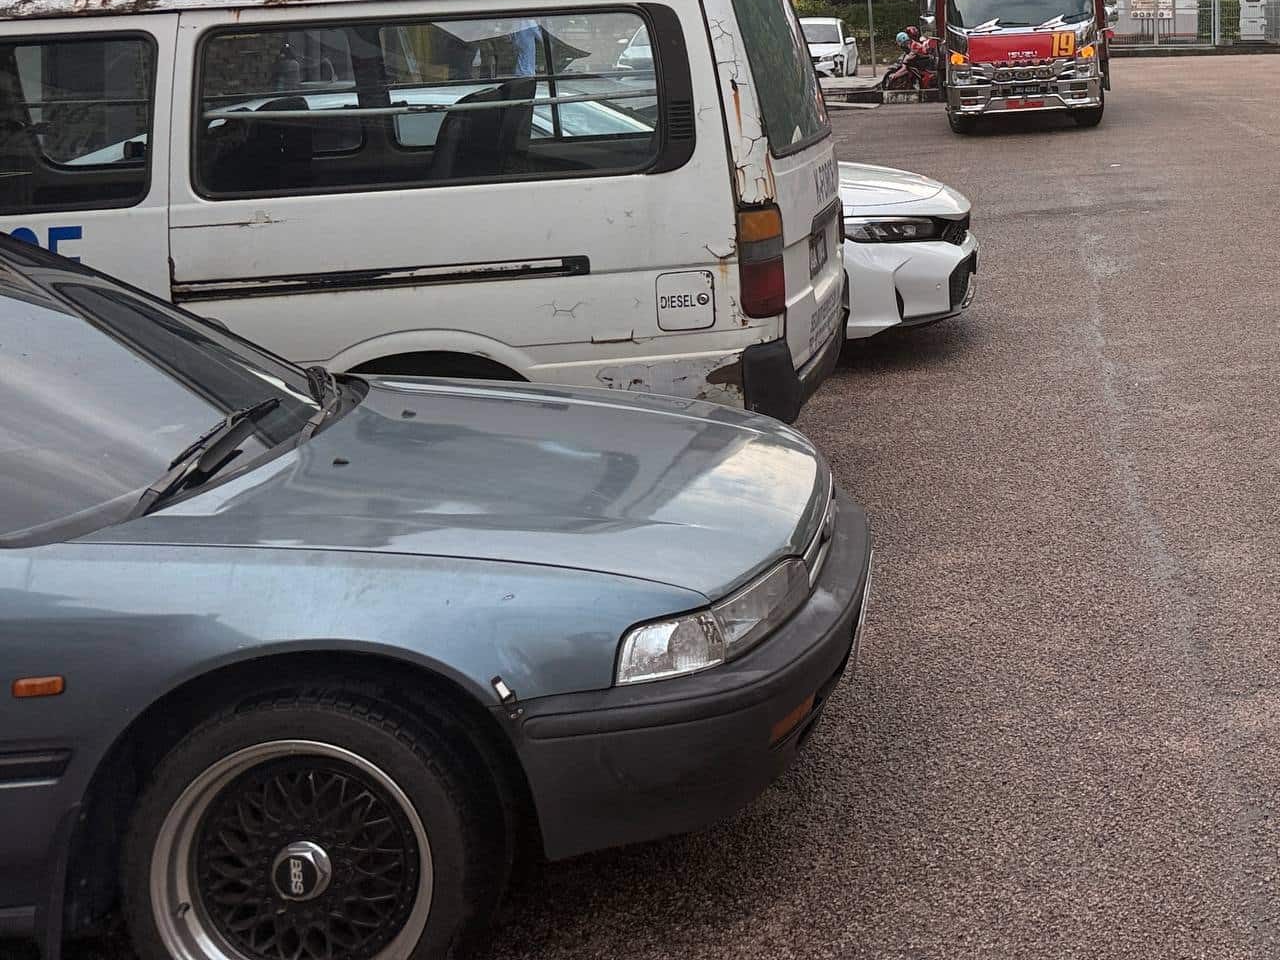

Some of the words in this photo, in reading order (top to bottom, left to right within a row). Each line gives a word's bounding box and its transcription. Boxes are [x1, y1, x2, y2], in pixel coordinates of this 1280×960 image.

[1051, 32, 1075, 57] 19
[660, 294, 696, 309] DIESEL
[290, 858, 305, 895] BBS
